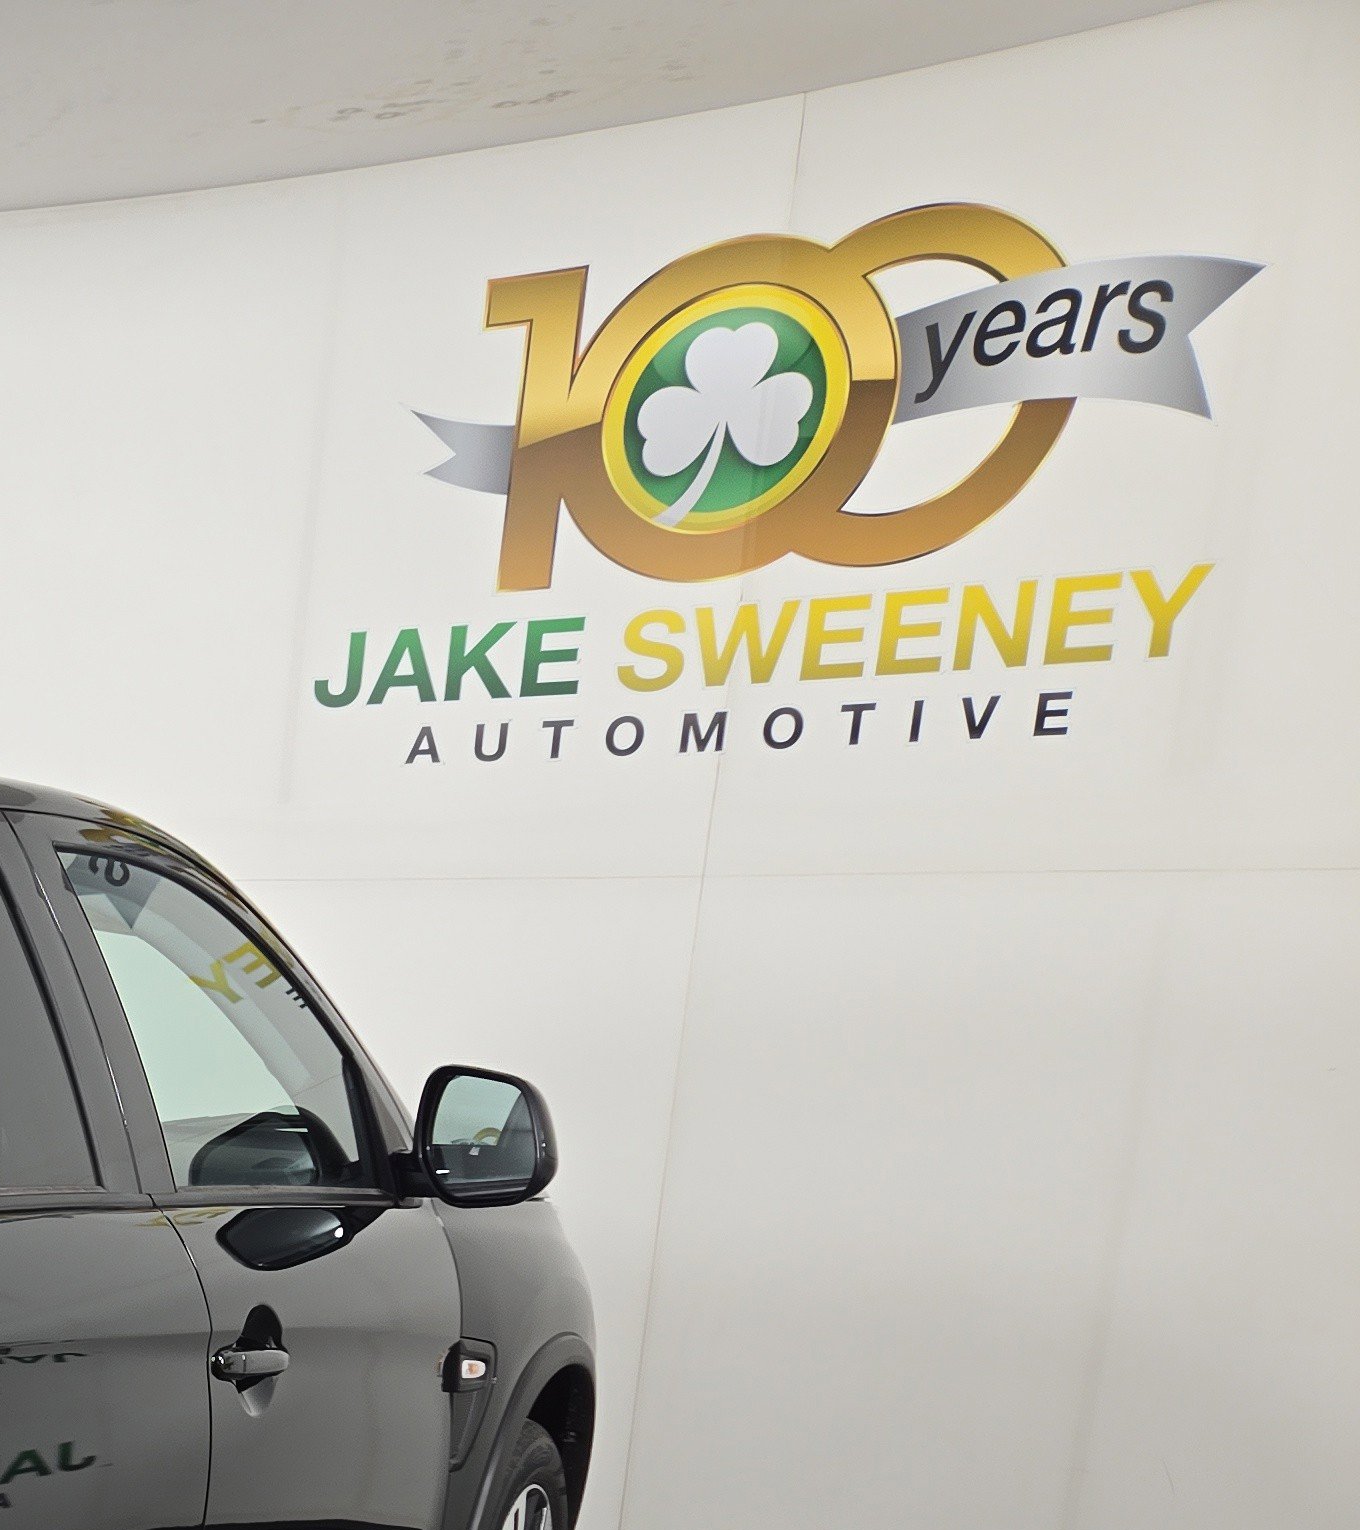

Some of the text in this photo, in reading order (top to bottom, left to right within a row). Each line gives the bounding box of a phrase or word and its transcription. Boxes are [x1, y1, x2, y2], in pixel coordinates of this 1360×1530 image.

[485, 202, 1078, 593] 100
[914, 279, 1173, 404] years
[313, 563, 1215, 708] JAKE SWEENEY
[406, 691, 1074, 765] AUTOMOTIVE
